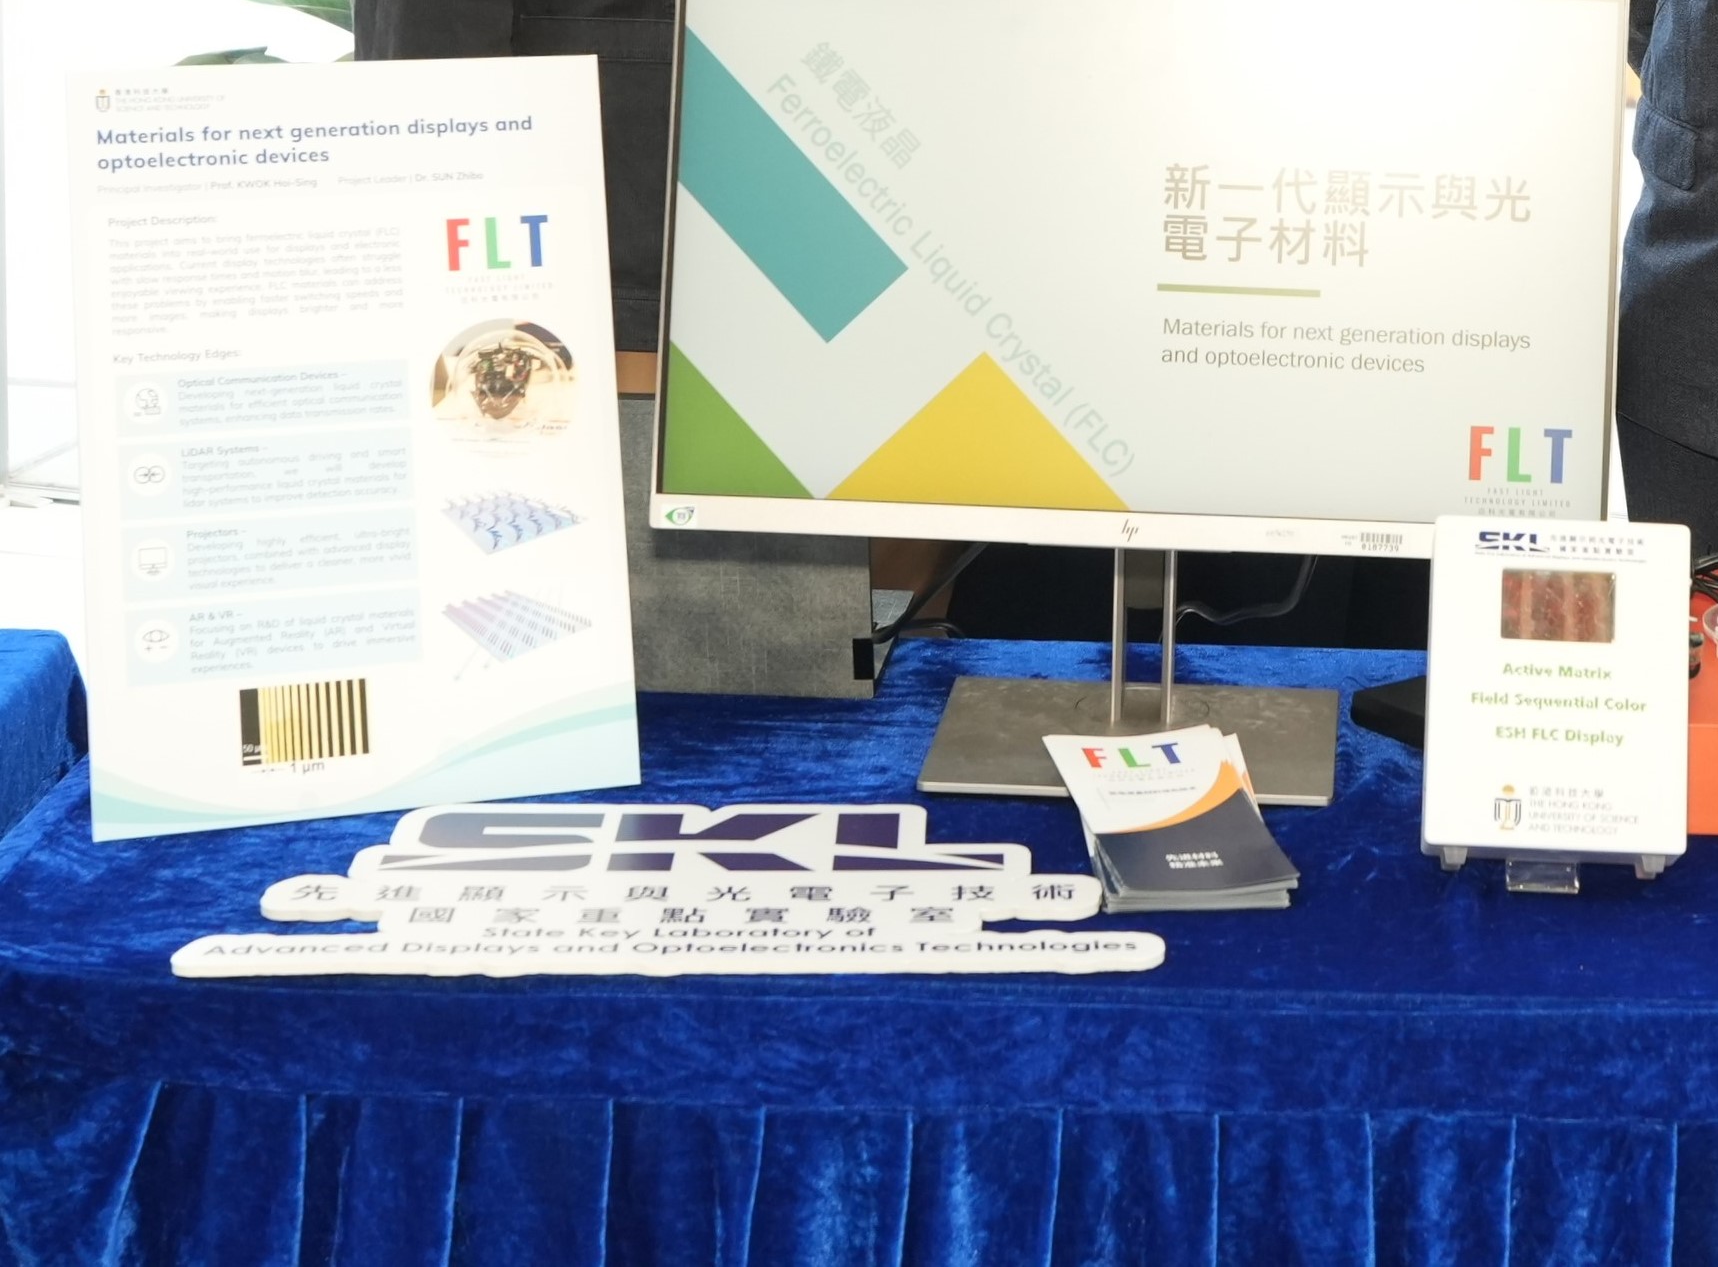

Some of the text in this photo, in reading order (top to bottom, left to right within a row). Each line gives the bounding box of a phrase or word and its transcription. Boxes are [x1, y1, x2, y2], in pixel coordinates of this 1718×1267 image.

[800, 41, 921, 170] 鐵電液晶
[96, 115, 533, 145] Materials for next generation displays and
[97, 147, 330, 173] optoelectronic devices
[210, 181, 233, 191] Prof.
[237, 179, 271, 189] KWOK
[414, 173, 429, 183] Dr.
[432, 172, 453, 182] SUN
[456, 171, 484, 181] Zhibo
[1163, 163, 1531, 222] 新一代顯示與光
[108, 217, 147, 229] Project
[446, 214, 548, 271] FLT
[1163, 214, 1368, 267] 電子材料
[766, 73, 1135, 477] Ferroelectric Liquid Crystal (FLC)
[1163, 318, 1531, 352] Materials for next generation displays
[113, 354, 133, 365] Key
[138, 350, 201, 362] Technology
[1161, 347, 1425, 372] and optoelectronic devices
[178, 370, 339, 389] Optical Communication Devices
[218, 445, 259, 456] Systems
[1468, 426, 1572, 484] FLT
[186, 527, 238, 539] Projectors
[1475, 531, 1550, 552] SKL
[189, 612, 204, 622] AR
[218, 610, 234, 620] VR
[1502, 663, 1612, 680] Active Matrix
[1471, 692, 1647, 712] Field Sequential Color
[1495, 726, 1624, 747] ESH FLC Display
[1081, 742, 1181, 769] FLT
[1549, 800, 1579, 810] HONG
[1582, 801, 1612, 811] KONG
[1528, 811, 1639, 824] UNIVERSITY OF SCIENCE
[1528, 823, 1618, 834] AND TECHNOLOGY
[378, 813, 1004, 871] SKL
[294, 883, 1075, 902] 先進顯示與光電子技術
[409, 906, 955, 924] 國家重點實驗室
[483, 926, 875, 941] State Key Laboratory of
[203, 938, 1137, 959] Advanced Displays and Optoelectronics Technologies
